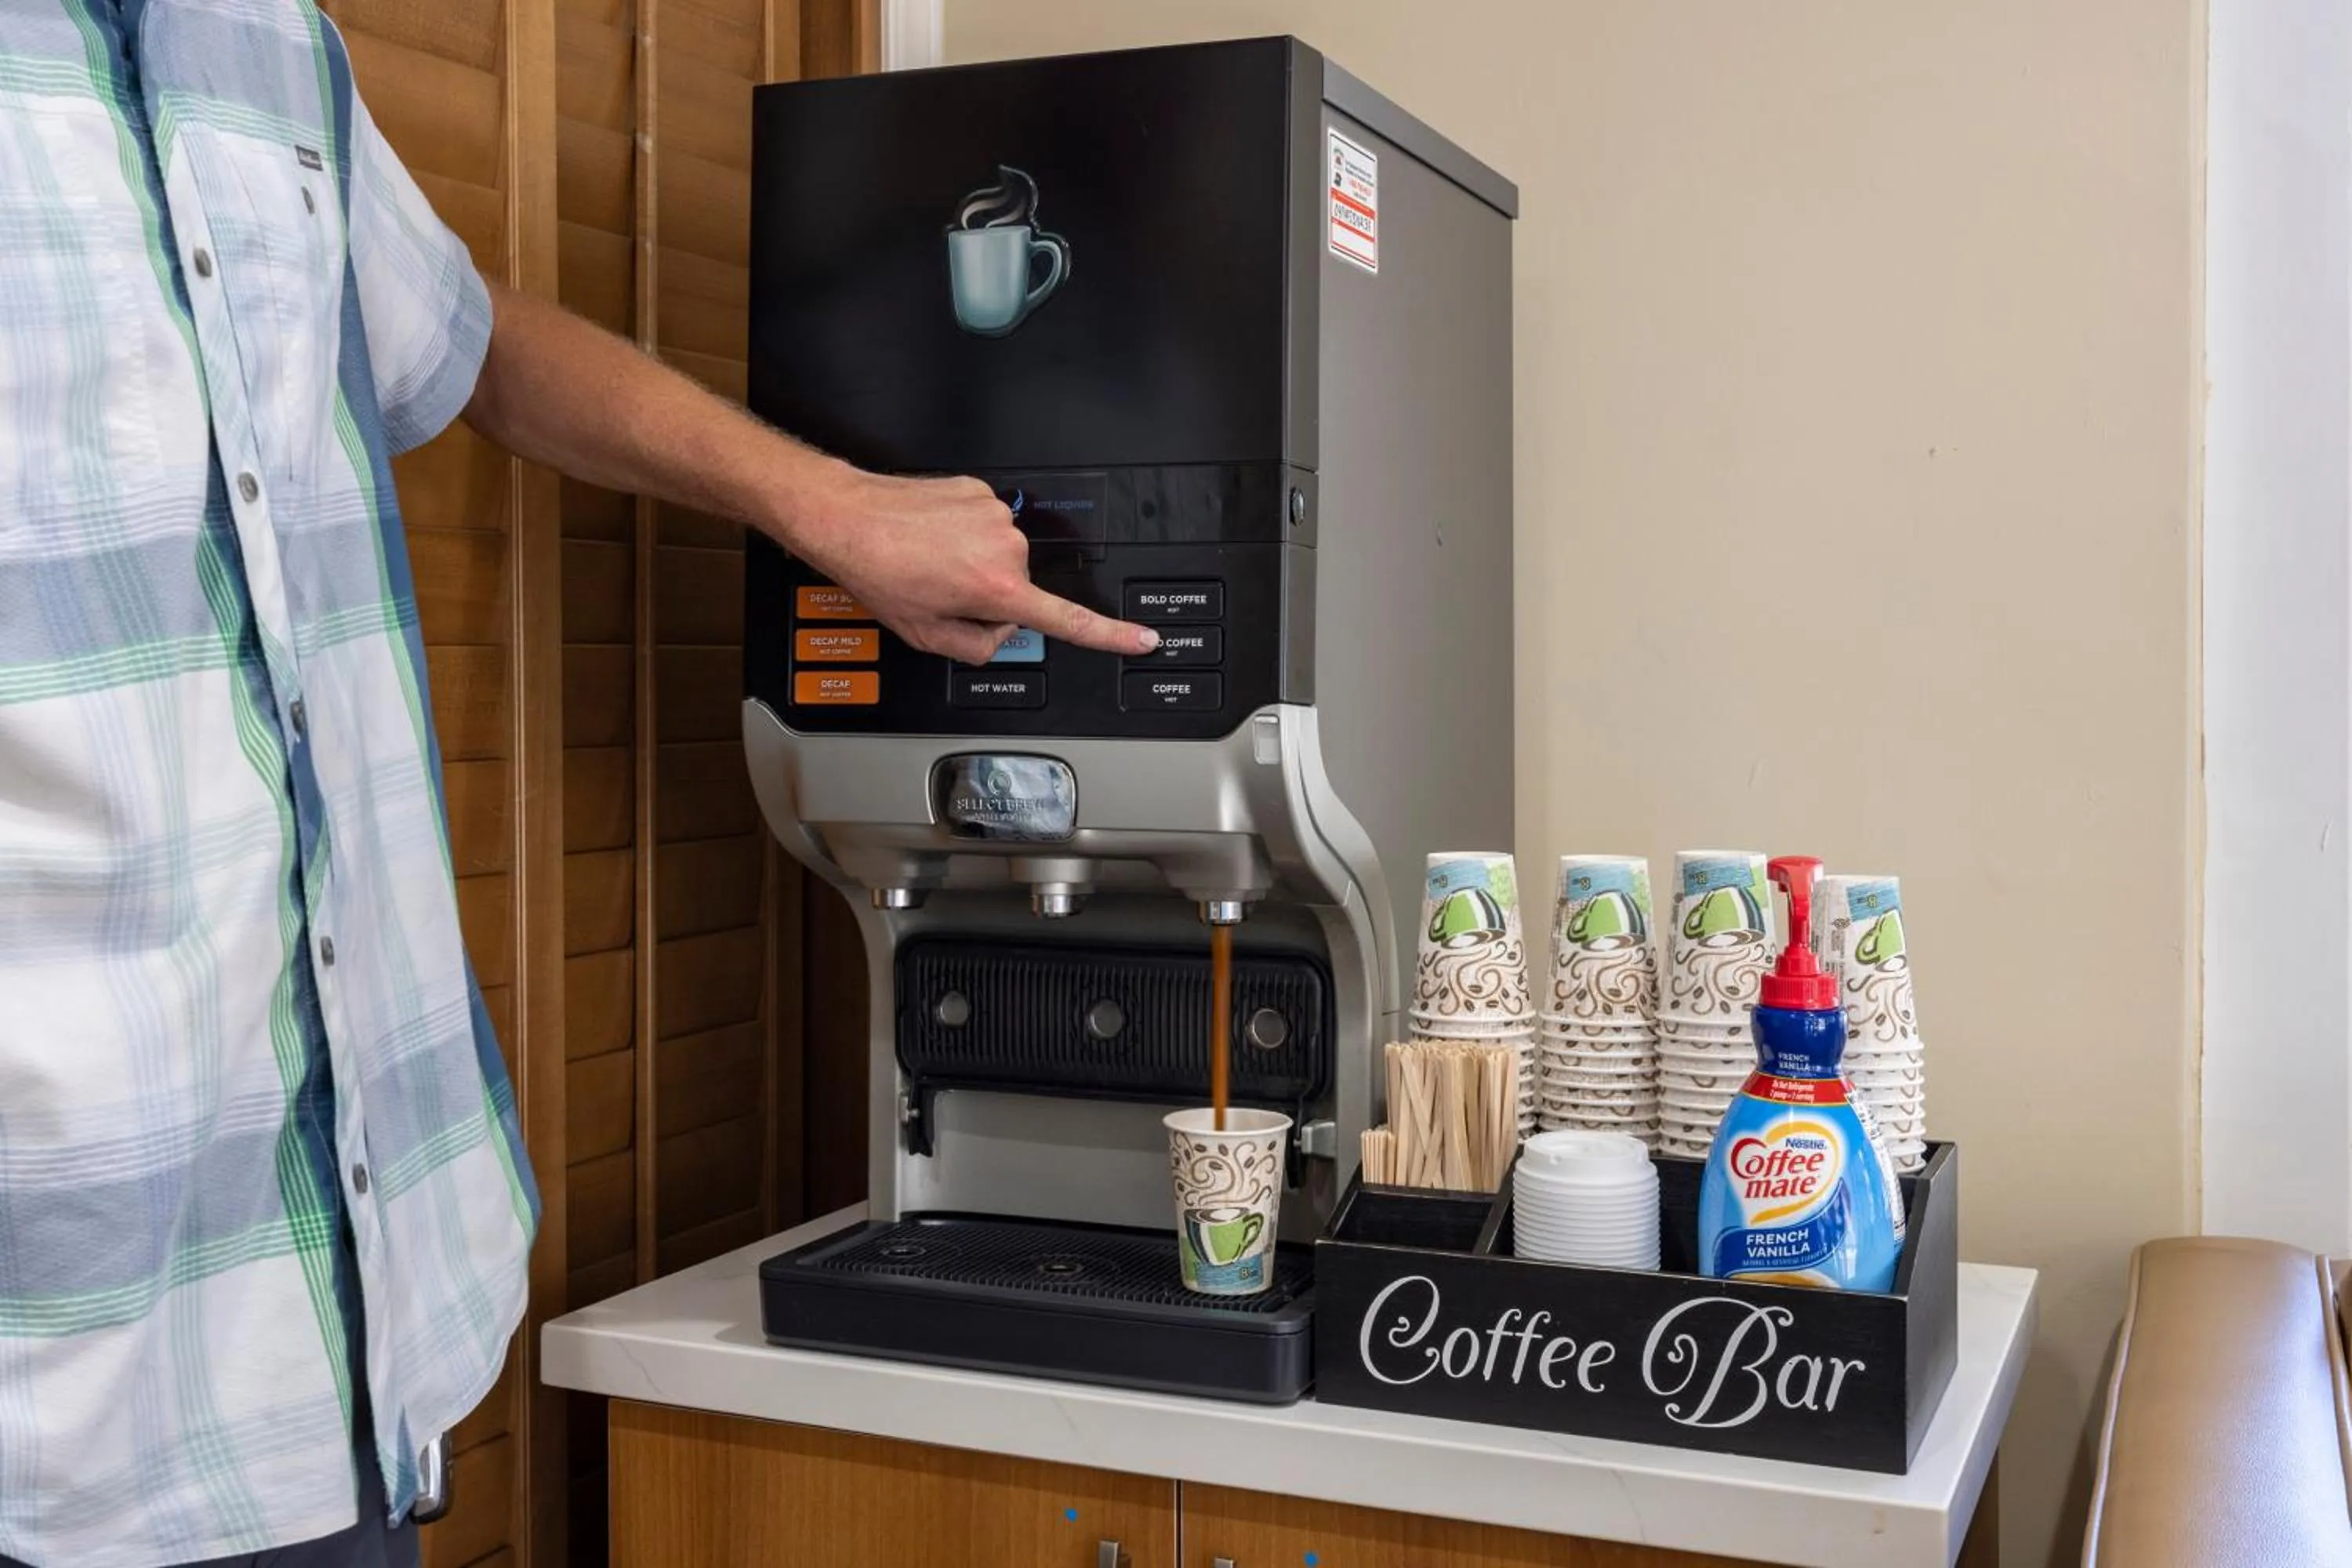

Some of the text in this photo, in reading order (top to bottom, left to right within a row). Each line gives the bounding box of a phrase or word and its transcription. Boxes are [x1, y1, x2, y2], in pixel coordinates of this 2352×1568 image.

[810, 593, 838, 603] DECAF
[1141, 595, 1207, 604] BOLD COFFEE
[810, 637, 862, 646] DECAF MILD
[1004, 639, 1029, 648] ATER
[1166, 638, 1203, 647] COFFEE
[821, 680, 851, 688] DECAF
[971, 684, 1025, 693] HOT WATER
[1152, 684, 1191, 694] COFFEE
[1778, 1051, 1810, 1062] FRENCH
[1730, 1137, 1825, 1180] Coffee
[1744, 1175, 1817, 1199] mate
[1746, 1227, 1809, 1246] FRENCH
[1747, 1241, 1811, 1258] VANILLA
[1359, 1275, 1867, 1429] Coffee Bar
